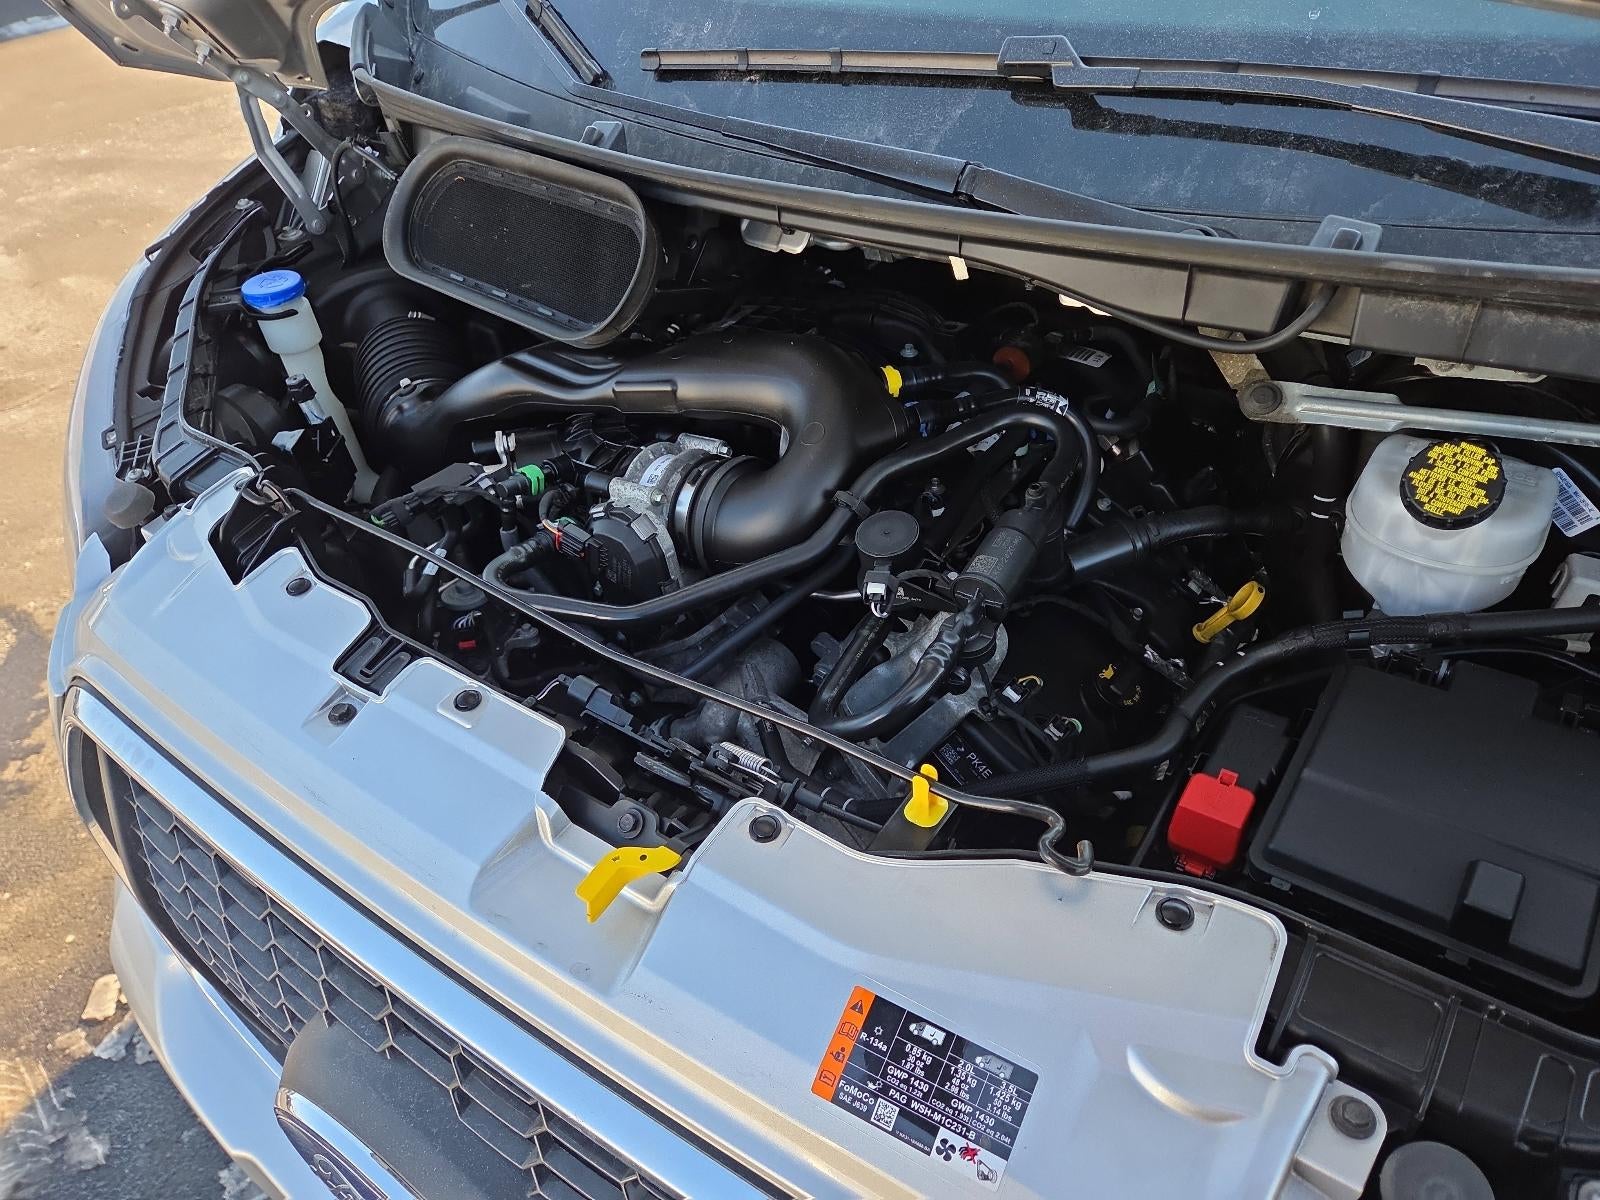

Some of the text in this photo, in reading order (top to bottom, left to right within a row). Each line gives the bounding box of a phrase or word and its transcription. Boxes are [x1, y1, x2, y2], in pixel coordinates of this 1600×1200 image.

[966, 752, 992, 779] PK4E
[859, 1031, 888, 1051] R-134a
[900, 1058, 914, 1071] 1.87
[906, 1053, 924, 1068] 30 oz
[920, 1050, 933, 1065] kg
[957, 1059, 976, 1074] 2.0L
[886, 1064, 929, 1092] GWP 1430
[886, 1074, 899, 1085] CO2
[949, 1066, 978, 1088] 1.35 kg
[951, 1076, 969, 1091] 48 oz
[837, 1079, 875, 1105] FoMoCo
[959, 1089, 970, 1100] lbs
[999, 1080, 1018, 1095] 3.5L
[838, 1091, 853, 1104] SAE
[930, 1098, 945, 1109] CO2
[988, 1085, 1022, 1110] 1.425 kg
[992, 1097, 1011, 1112] 50 oz
[887, 1087, 908, 1104] PAG
[909, 1099, 976, 1140] WSH-M1C231-B
[950, 1097, 995, 1126] GWP 1430
[986, 1103, 1013, 1121] 3.14 lbs
[971, 1119, 985, 1130] CO2
